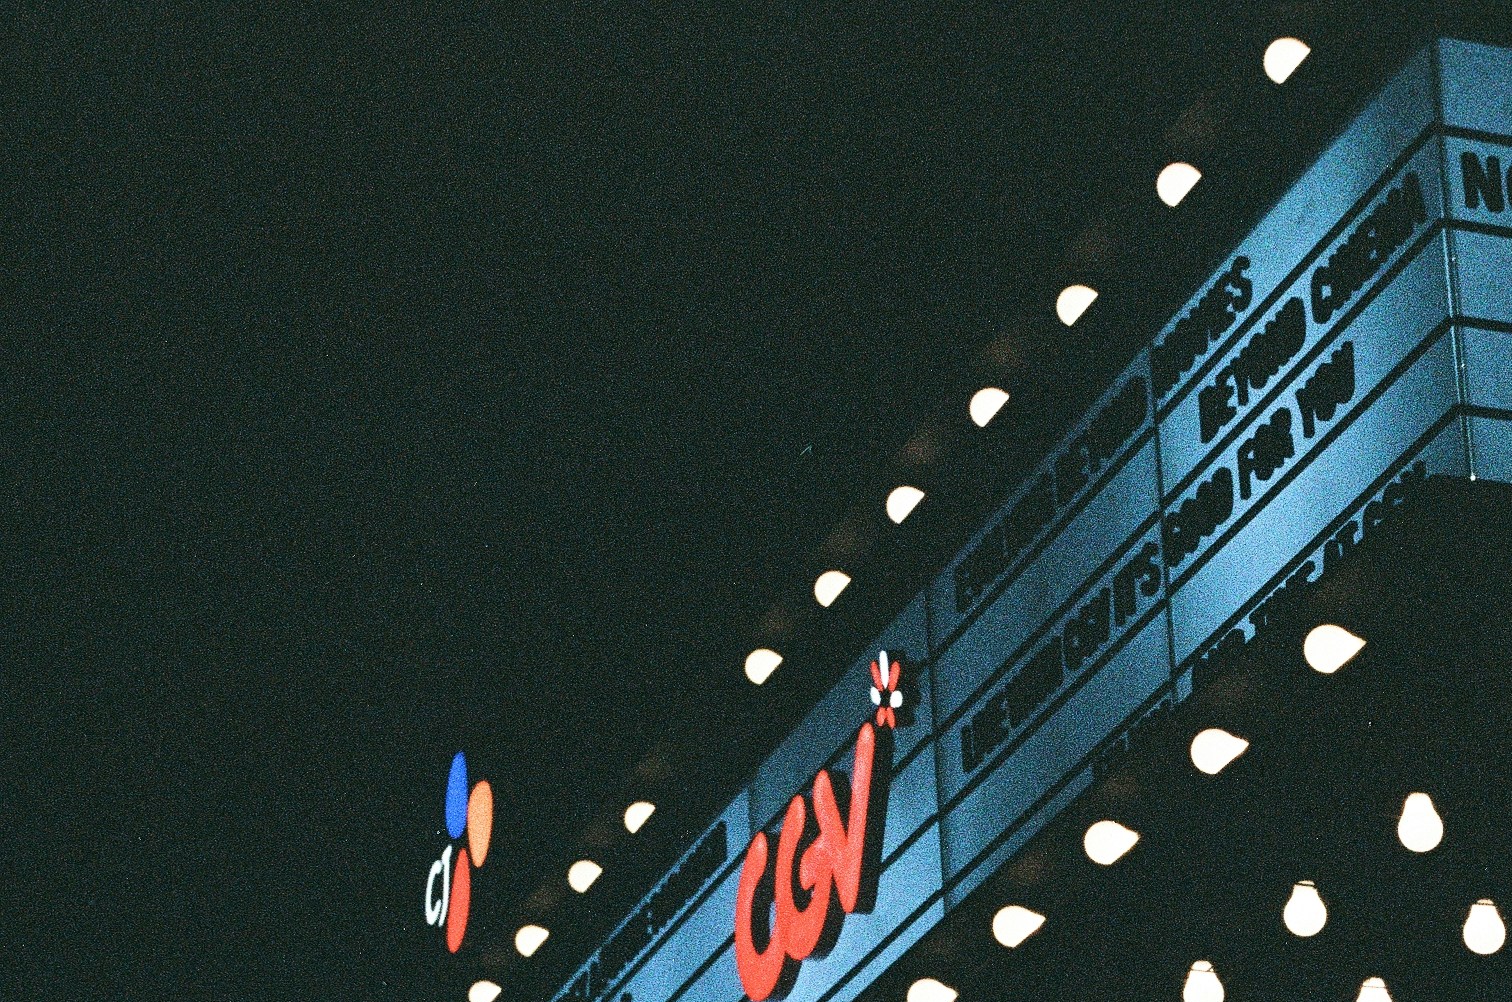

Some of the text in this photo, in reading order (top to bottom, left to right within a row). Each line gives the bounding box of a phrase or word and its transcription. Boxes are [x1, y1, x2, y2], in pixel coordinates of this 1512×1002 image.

[1150, 256, 1251, 399] MOVIES
[1199, 298, 1305, 442] BEYOND
[1312, 171, 1426, 323] CINEMA
[1162, 468, 1233, 567] GOOD
[1238, 408, 1294, 499] FOR
[1296, 342, 1355, 438] YOU
[735, 718, 877, 1002] CGV
